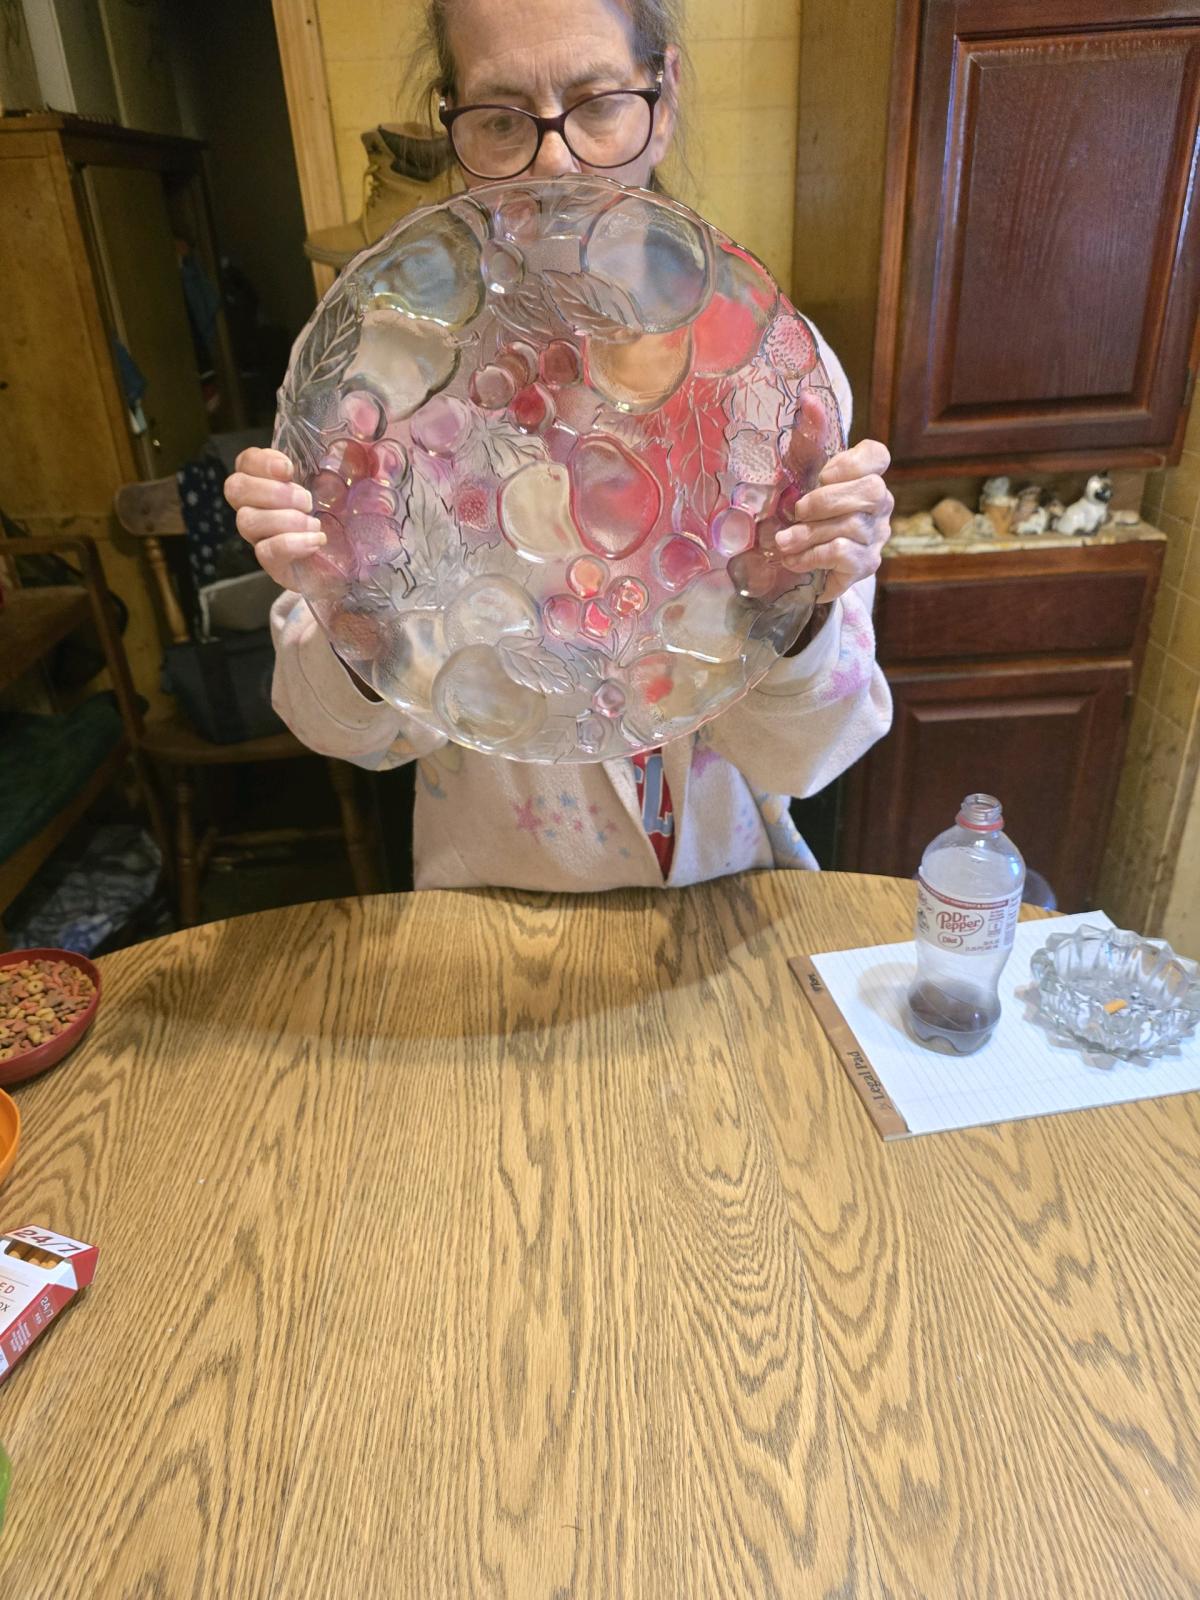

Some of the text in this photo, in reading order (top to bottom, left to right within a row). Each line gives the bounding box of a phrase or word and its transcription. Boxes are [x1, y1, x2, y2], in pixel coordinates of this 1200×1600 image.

[937, 911, 981, 932] Pepper
[952, 912, 970, 922] Dr
[847, 1050, 885, 1100] Legal Pad
[15, 1229, 82, 1252] 24/7
